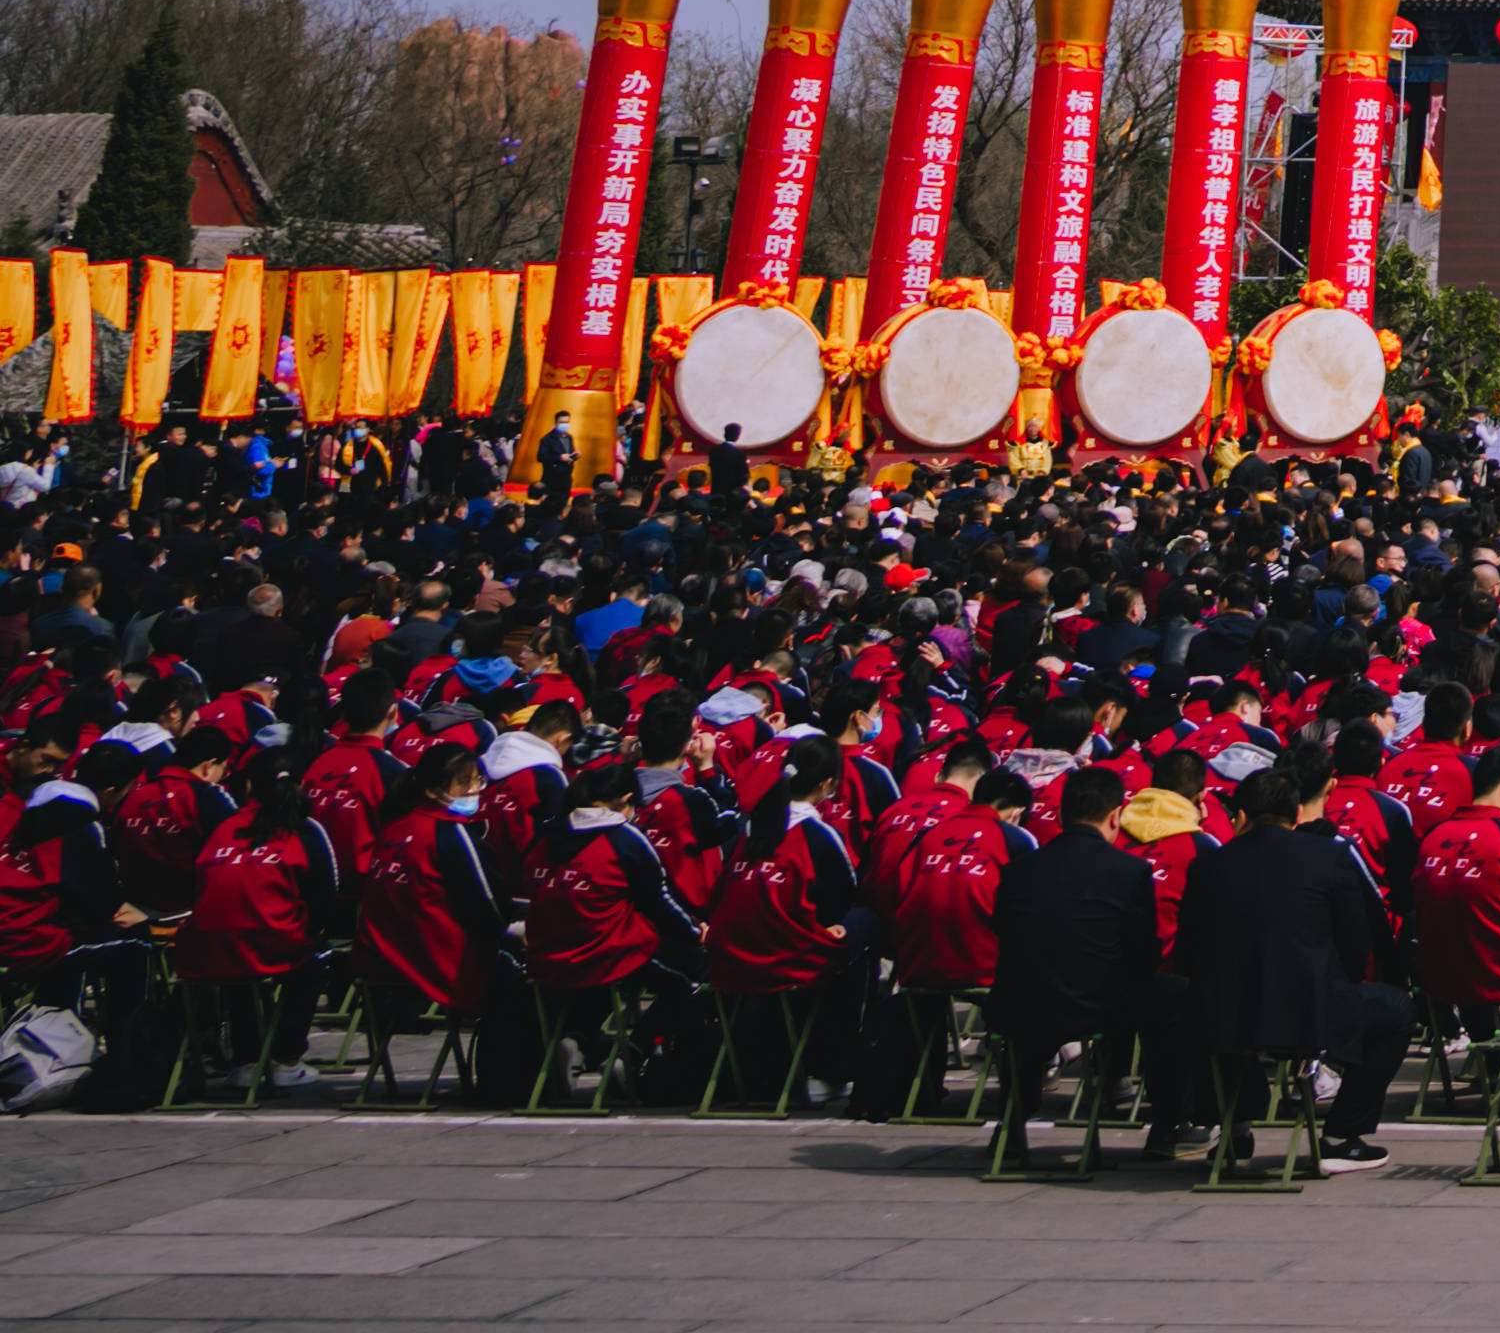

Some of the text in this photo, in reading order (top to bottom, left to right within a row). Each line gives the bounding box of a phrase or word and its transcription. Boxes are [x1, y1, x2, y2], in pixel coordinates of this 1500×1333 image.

[581, 70, 652, 337] 办实事开新局夯实根基
[760, 76, 822, 285] 凝心聚力奋发时代
[1046, 88, 1094, 337] 标准建构文旅融合格局
[1193, 78, 1241, 322] 德孝祖功誉传华人老家
[1345, 98, 1381, 314] 旅游为民打造文明单
